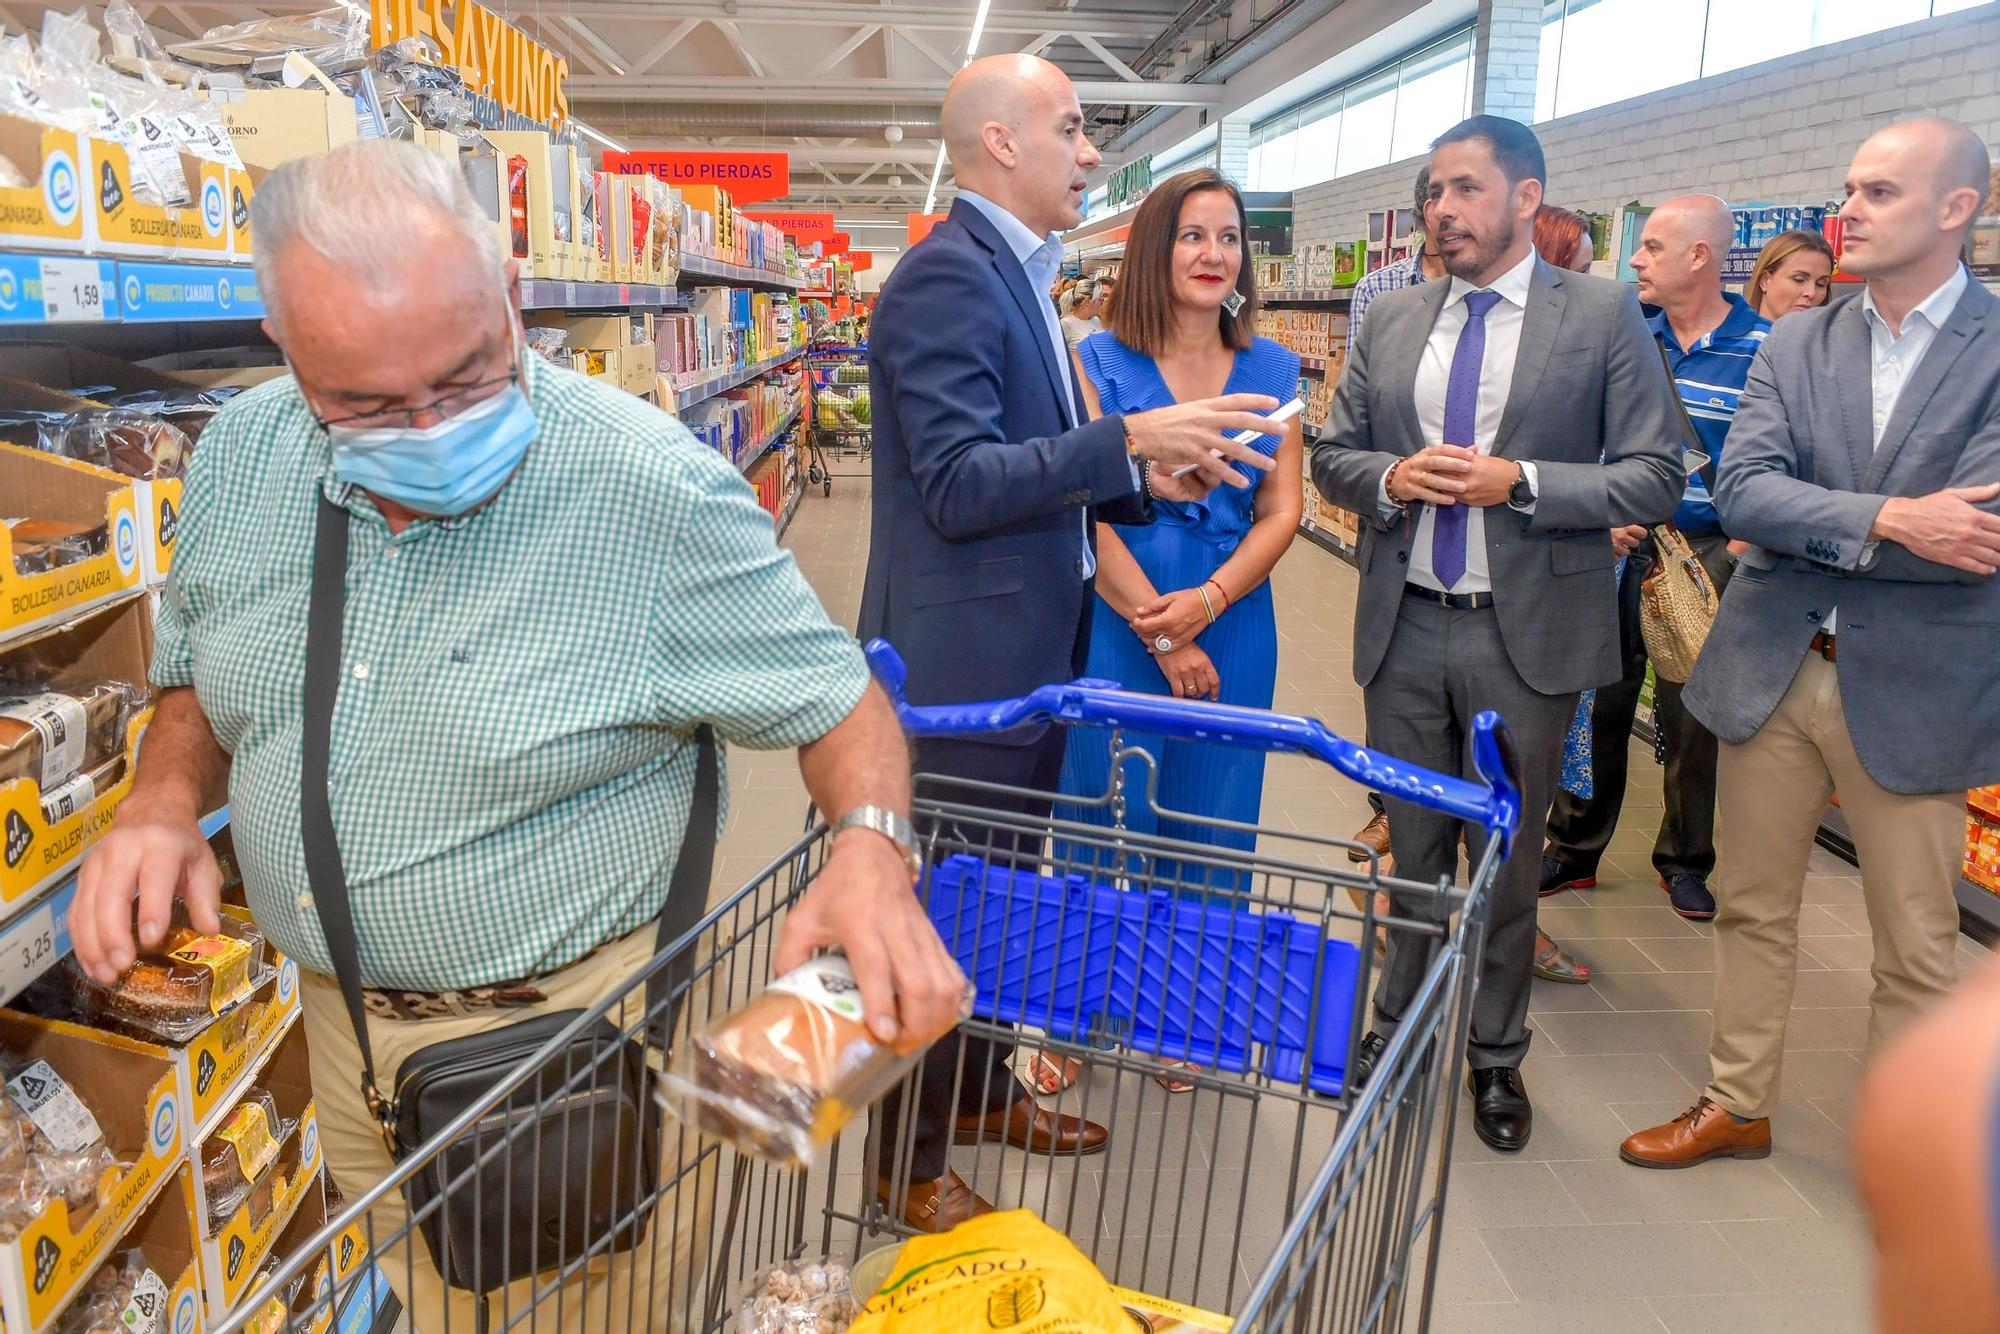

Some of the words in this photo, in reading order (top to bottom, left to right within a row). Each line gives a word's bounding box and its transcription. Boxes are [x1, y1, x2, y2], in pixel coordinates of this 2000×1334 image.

[619, 163, 643, 175] NO
[648, 163, 669, 178] TE
[674, 163, 695, 178] LO
[700, 164, 773, 179] PIERDAS
[782, 219, 825, 229] PIERDAS
[73, 285, 99, 308] 1,59
[66, 570, 111, 596] CANARIA
[43, 824, 91, 864] BOLLERA
[21, 931, 51, 969] 3,25
